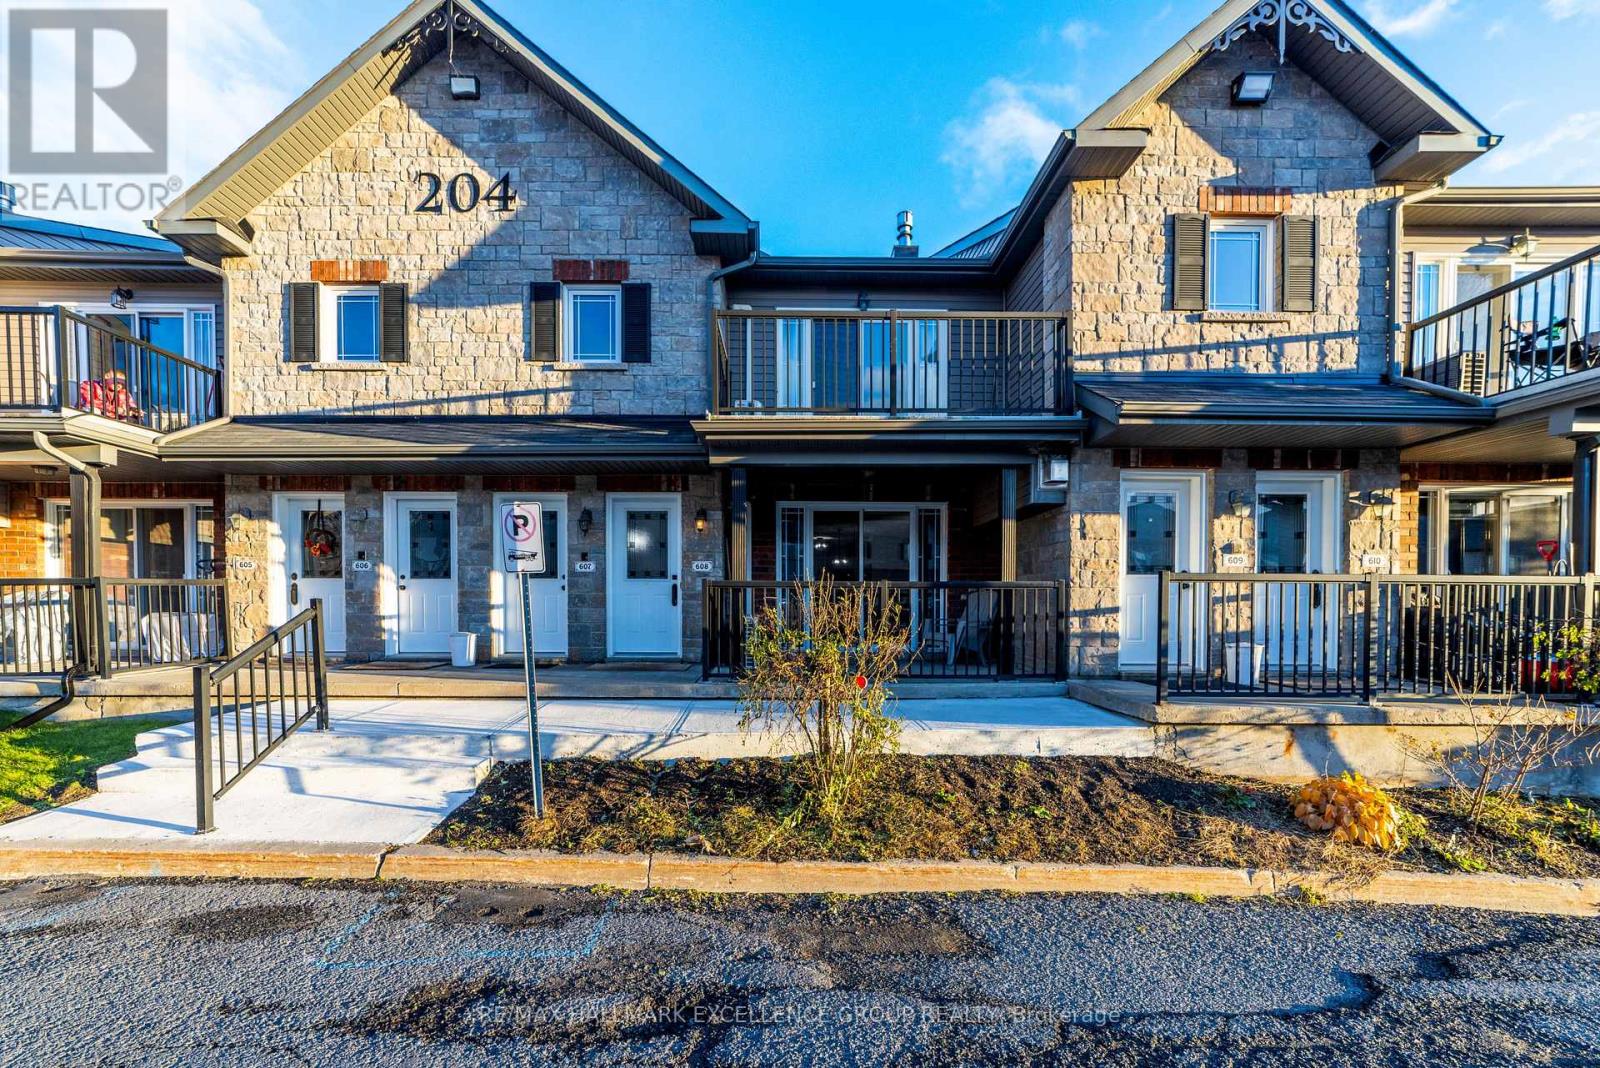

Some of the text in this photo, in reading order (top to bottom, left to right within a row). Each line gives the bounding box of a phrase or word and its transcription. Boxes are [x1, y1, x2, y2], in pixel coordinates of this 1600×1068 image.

[414, 171, 517, 214] 204
[513, 514, 529, 536] P
[1227, 556, 1244, 565] 609
[1368, 557, 1381, 565] 610
